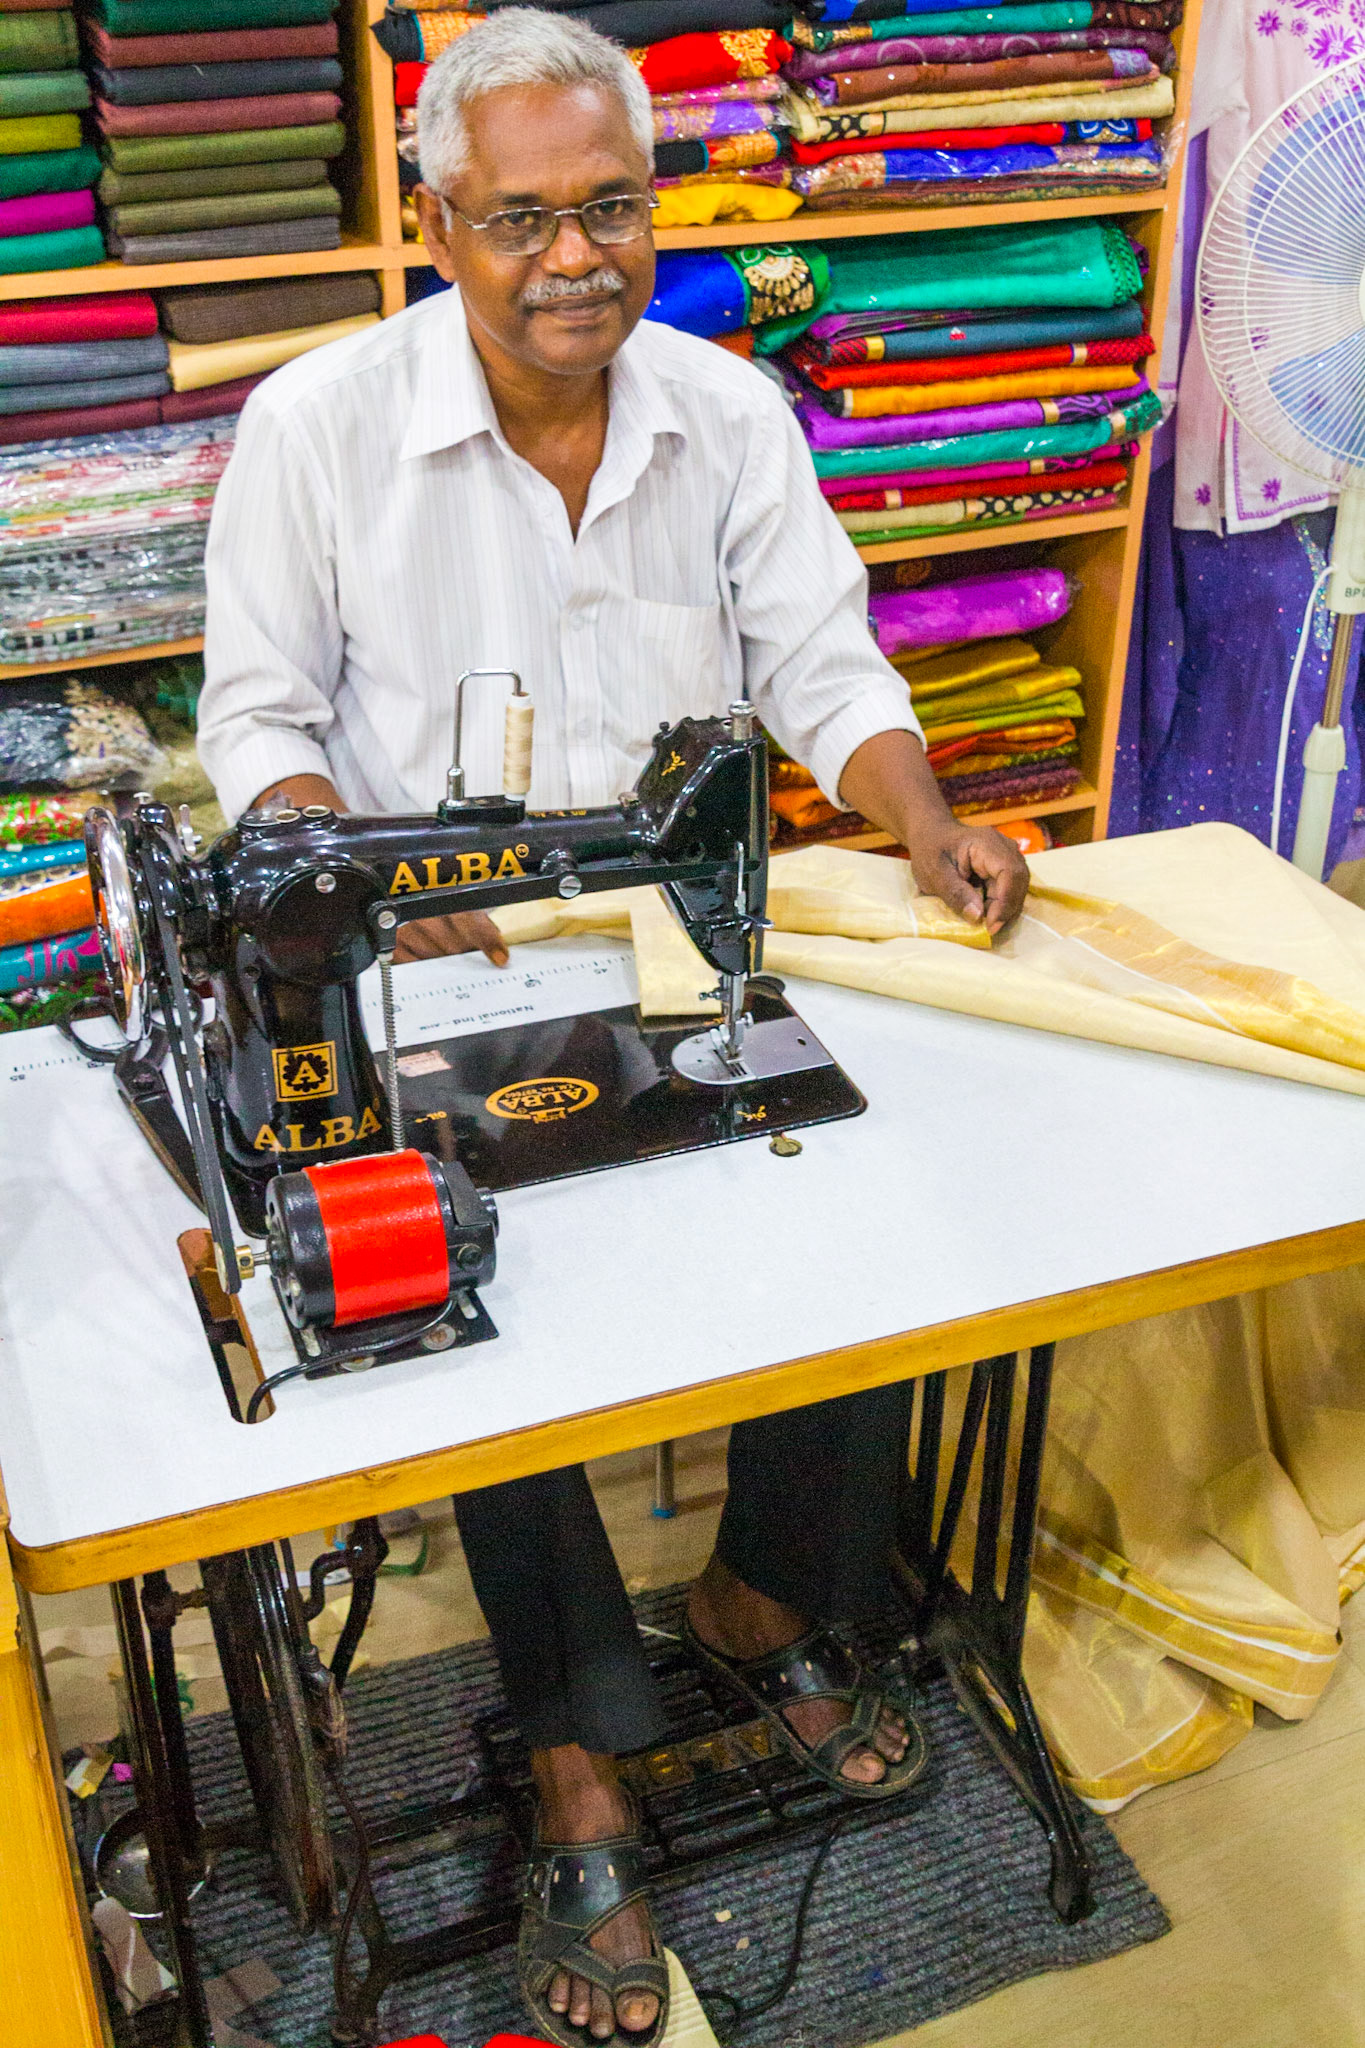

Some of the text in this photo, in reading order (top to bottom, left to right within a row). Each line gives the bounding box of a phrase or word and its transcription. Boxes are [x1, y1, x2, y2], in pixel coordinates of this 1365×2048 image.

[389, 848, 527, 895] ALBA
[479, 1005, 534, 1021] National
[291, 1060, 321, 1085] A
[499, 1087, 583, 1110] ALBA
[253, 1106, 382, 1153] ALBA
